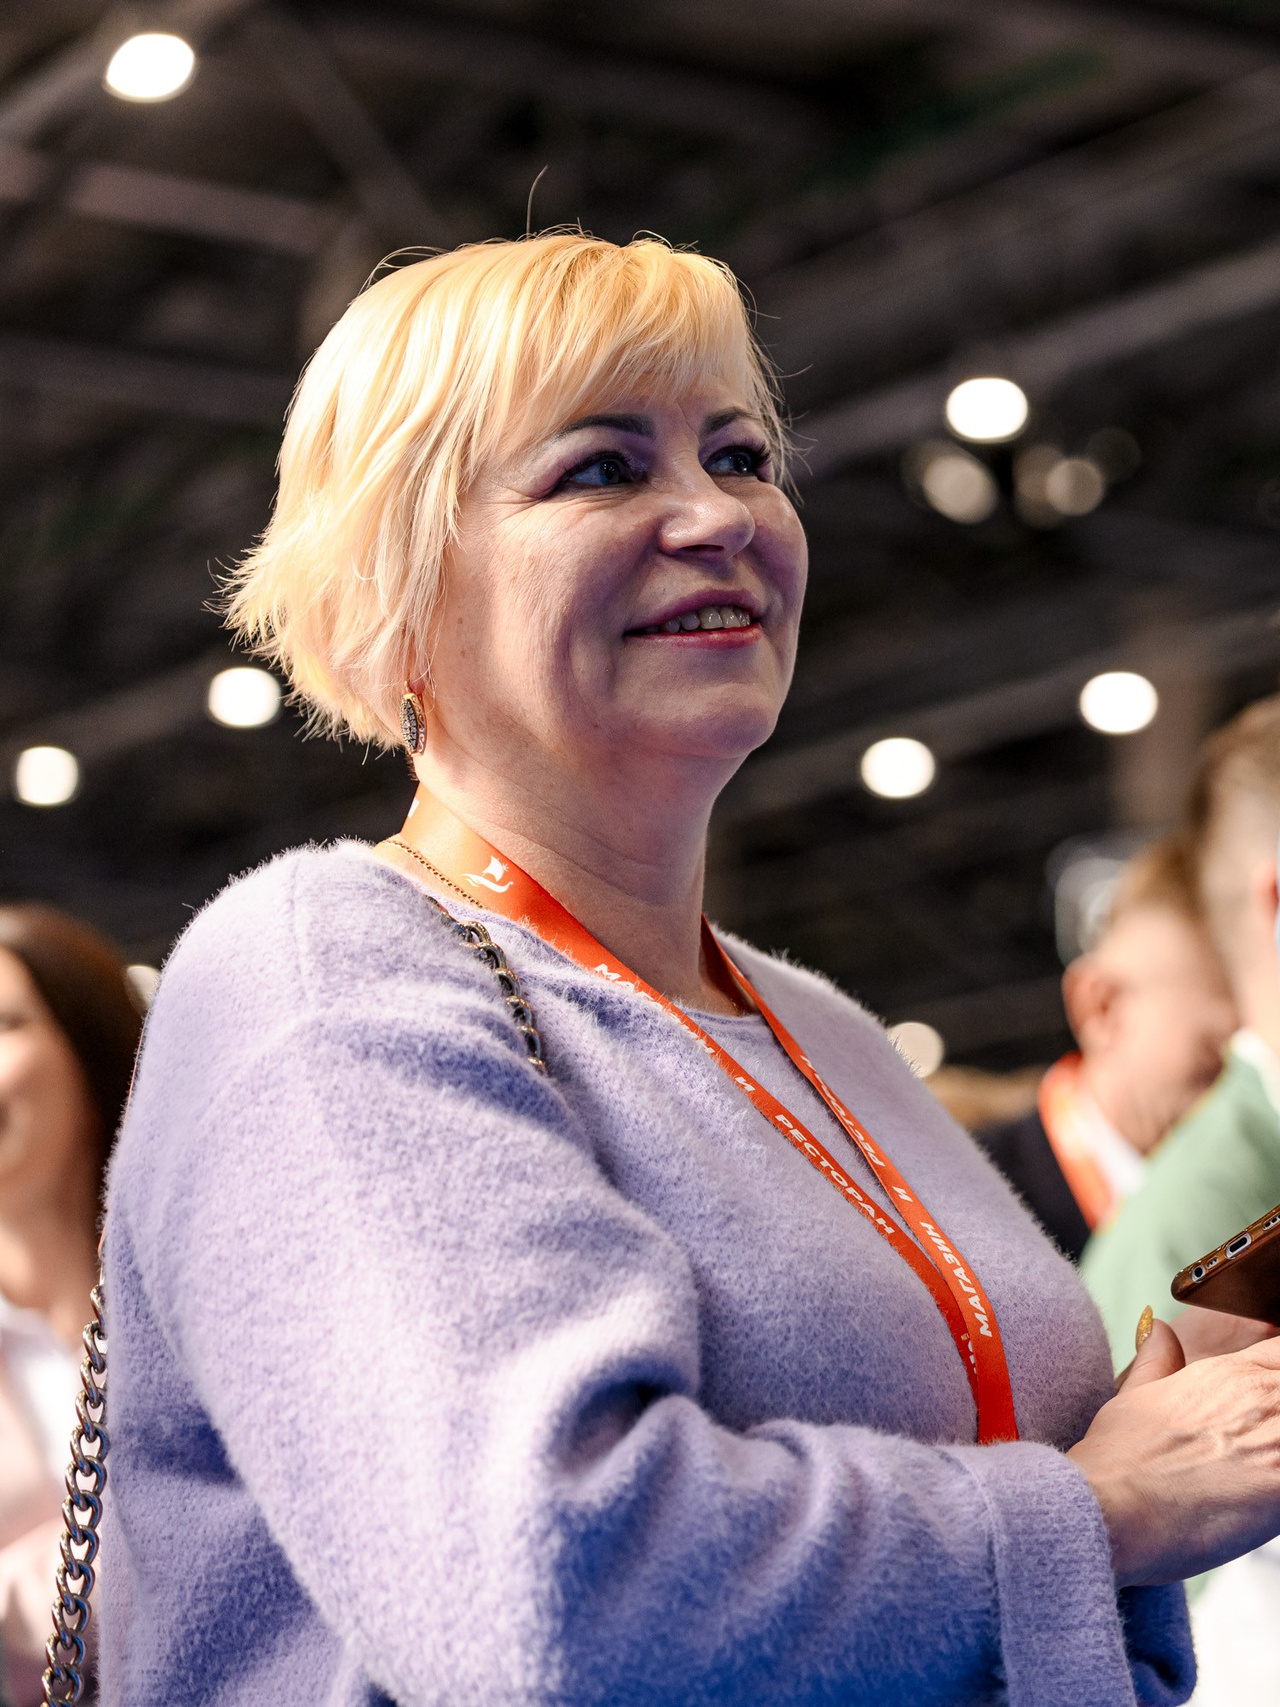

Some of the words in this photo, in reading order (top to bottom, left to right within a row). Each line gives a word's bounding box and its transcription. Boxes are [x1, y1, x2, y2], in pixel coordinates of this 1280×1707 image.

[734, 1076, 756, 1092] И
[774, 1113, 895, 1234] РЕСТОРАН
[891, 1185, 914, 1203] И
[919, 1221, 993, 1338] МАГАЗИН
